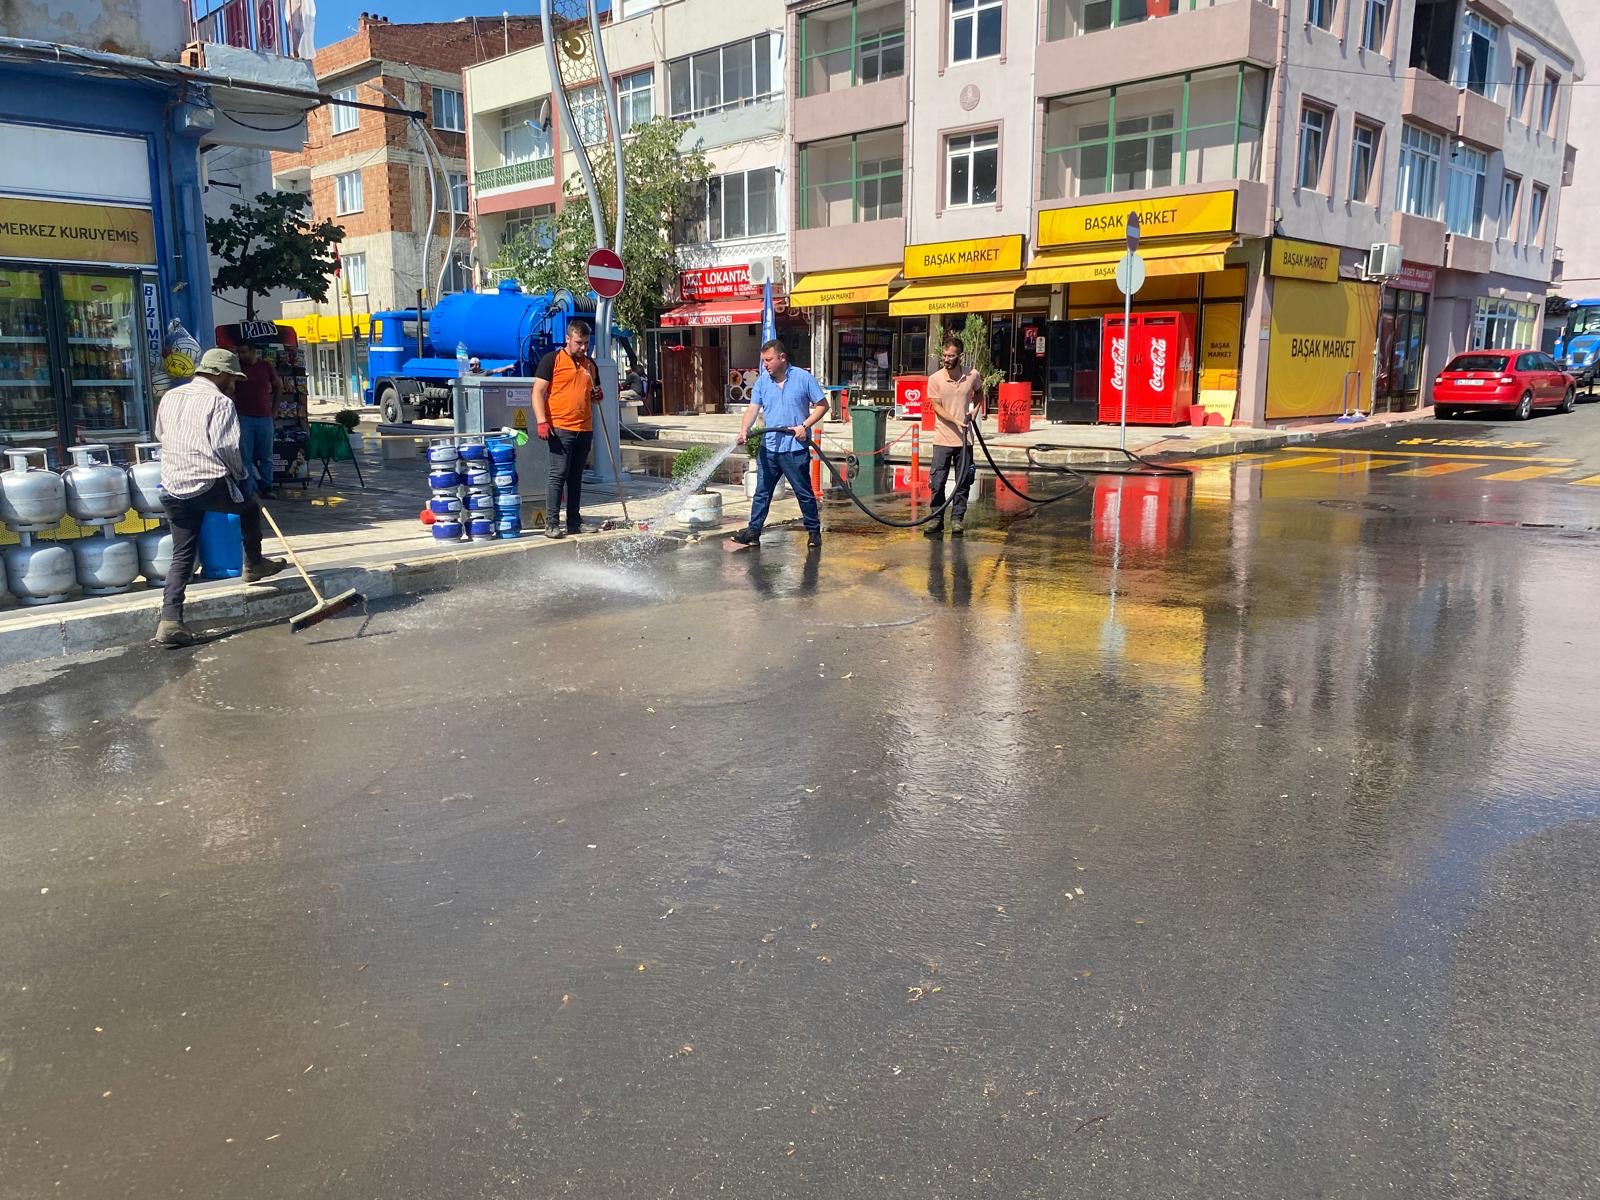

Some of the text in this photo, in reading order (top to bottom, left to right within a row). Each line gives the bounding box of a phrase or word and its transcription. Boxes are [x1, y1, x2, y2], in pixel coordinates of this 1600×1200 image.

[1084, 209, 1178, 232] BAŞAK ARKET
[0, 222, 139, 245] MERKEZ KURUYEMİŞ
[923, 248, 999, 268] BAŞAK MARKET
[1283, 252, 1328, 270] BAŞAK MARKET
[1094, 267, 1115, 277] BAŞAK
[820, 291, 854, 302] BAŞAK MARKET
[928, 300, 969, 311] BAŞAK MARKET
[1210, 342, 1231, 350] BAŞAK
[1291, 338, 1356, 362] BAŞAK MARKET
